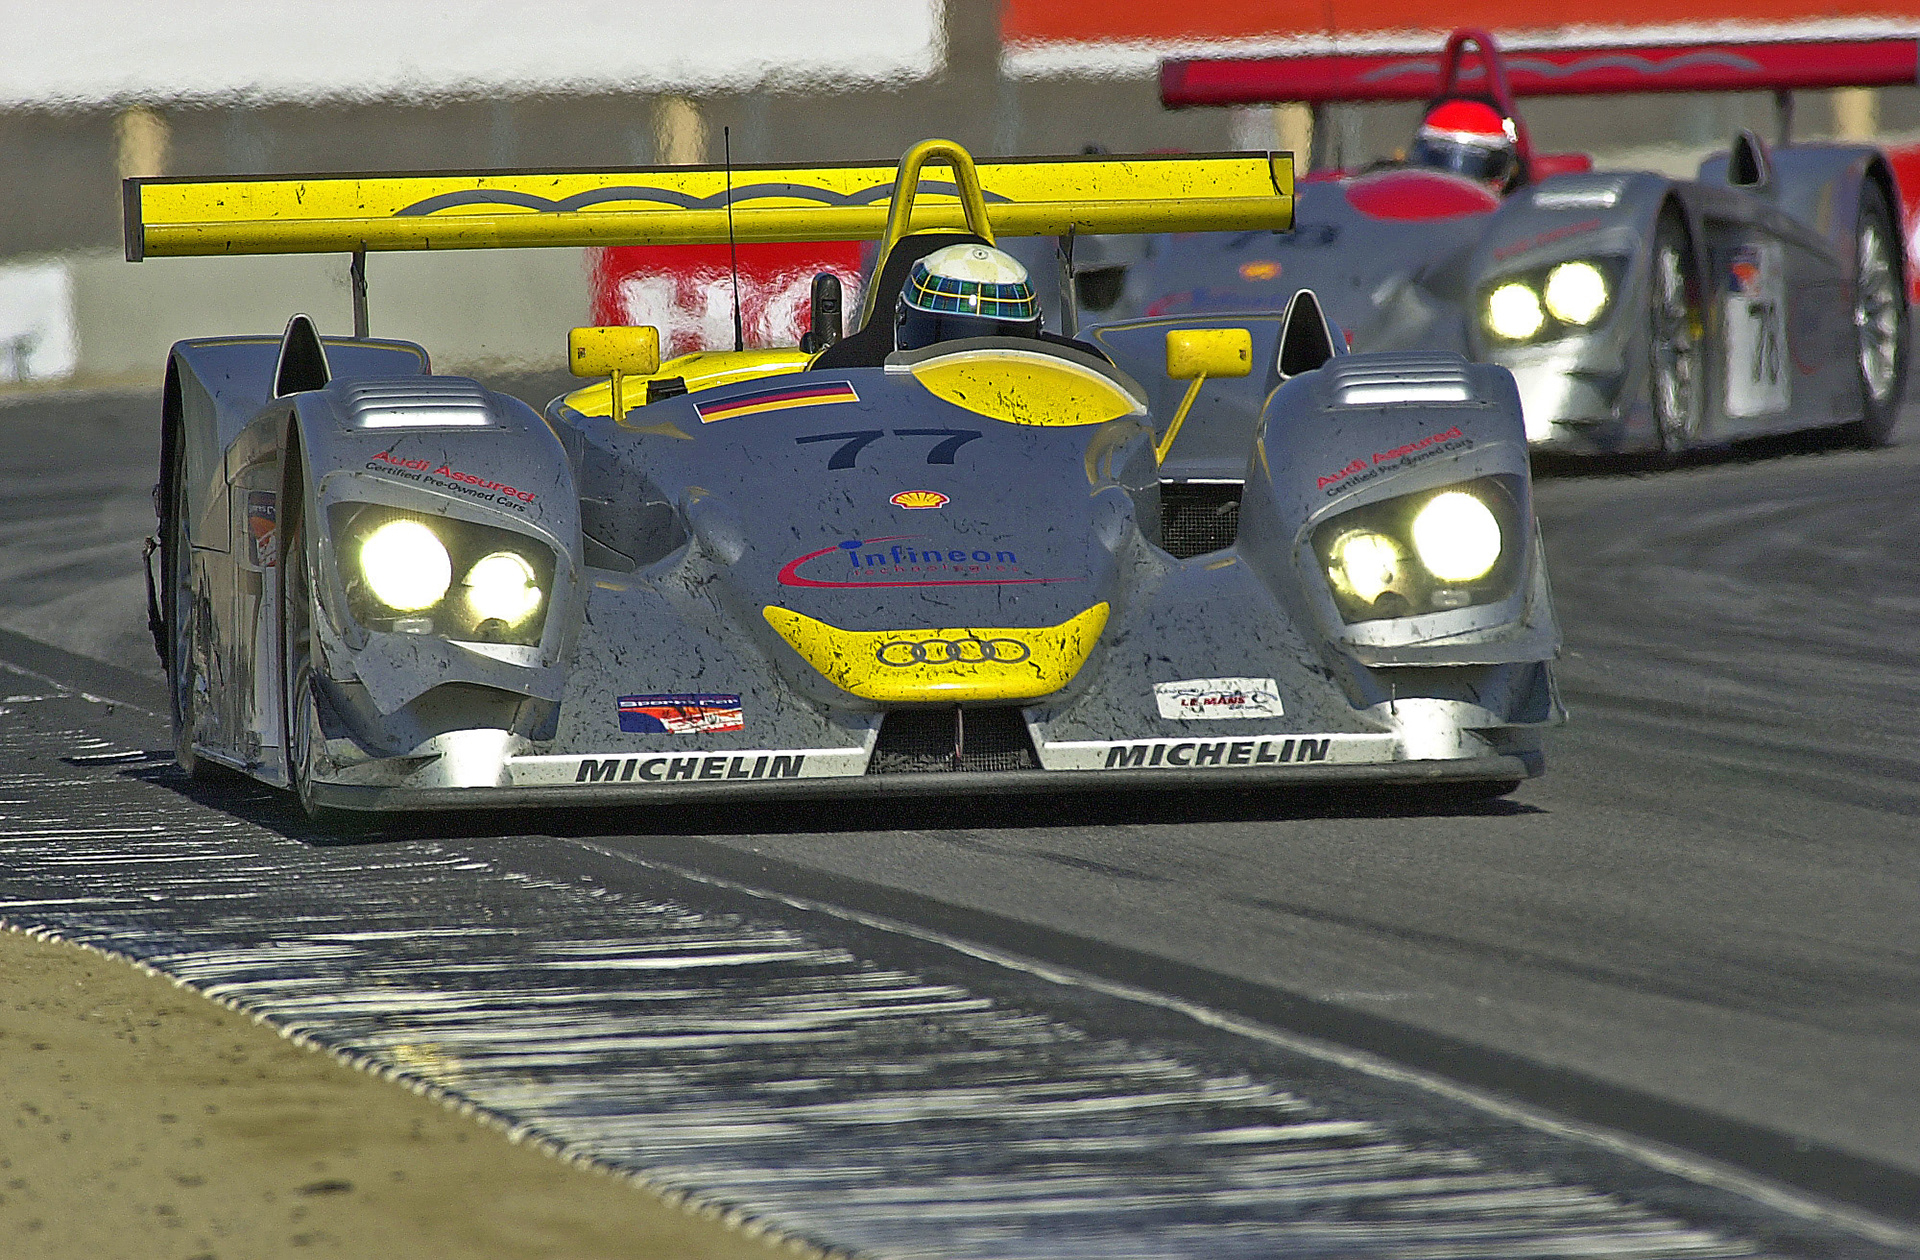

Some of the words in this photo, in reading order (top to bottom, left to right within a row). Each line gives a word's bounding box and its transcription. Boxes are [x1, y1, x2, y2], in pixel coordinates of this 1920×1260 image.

[795, 428, 984, 471] 77
[1317, 457, 1369, 490] Audi
[1372, 425, 1464, 464] Assured
[365, 461, 422, 482] Certified
[423, 475, 495, 502] Pre-Owned
[497, 496, 526, 513] Cars
[371, 450, 431, 472] Audi
[432, 464, 536, 504] Assured
[1326, 467, 1377, 497] Certified
[575, 754, 806, 783] MICHELIN
[1104, 738, 1332, 769] MICHELIN
